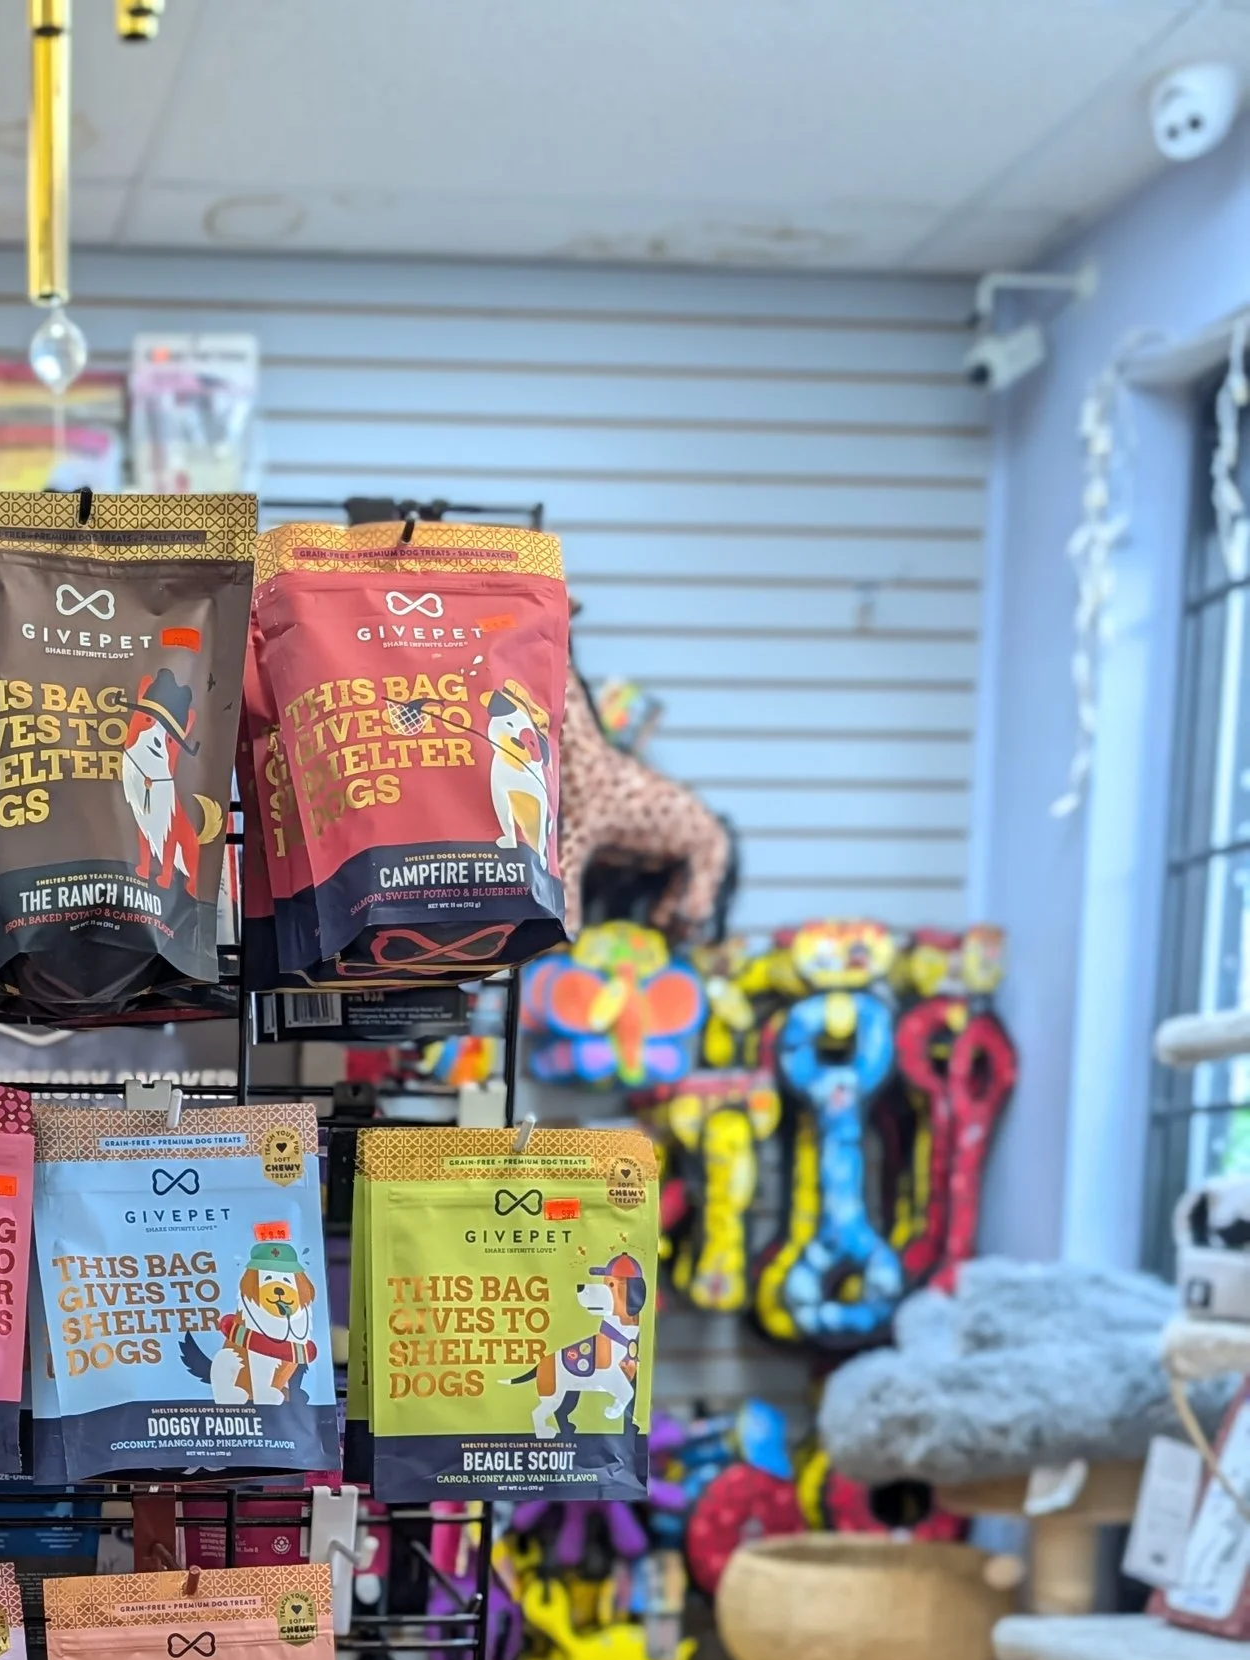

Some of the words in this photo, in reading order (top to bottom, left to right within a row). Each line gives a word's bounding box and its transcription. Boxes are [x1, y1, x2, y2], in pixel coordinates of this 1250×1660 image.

[380, 864, 468, 888] CAMPFIRE
[474, 863, 525, 883] FEAST
[19, 888, 52, 913] THE
[58, 884, 117, 908] RANCH
[123, 886, 161, 916] HAND
[465, 1230, 572, 1243] GIVEPET
[148, 1418, 198, 1437] DOGGY
[205, 1417, 263, 1436] PADDLE
[464, 1452, 523, 1471] BEAGLE
[529, 1452, 576, 1470] SCOUT
